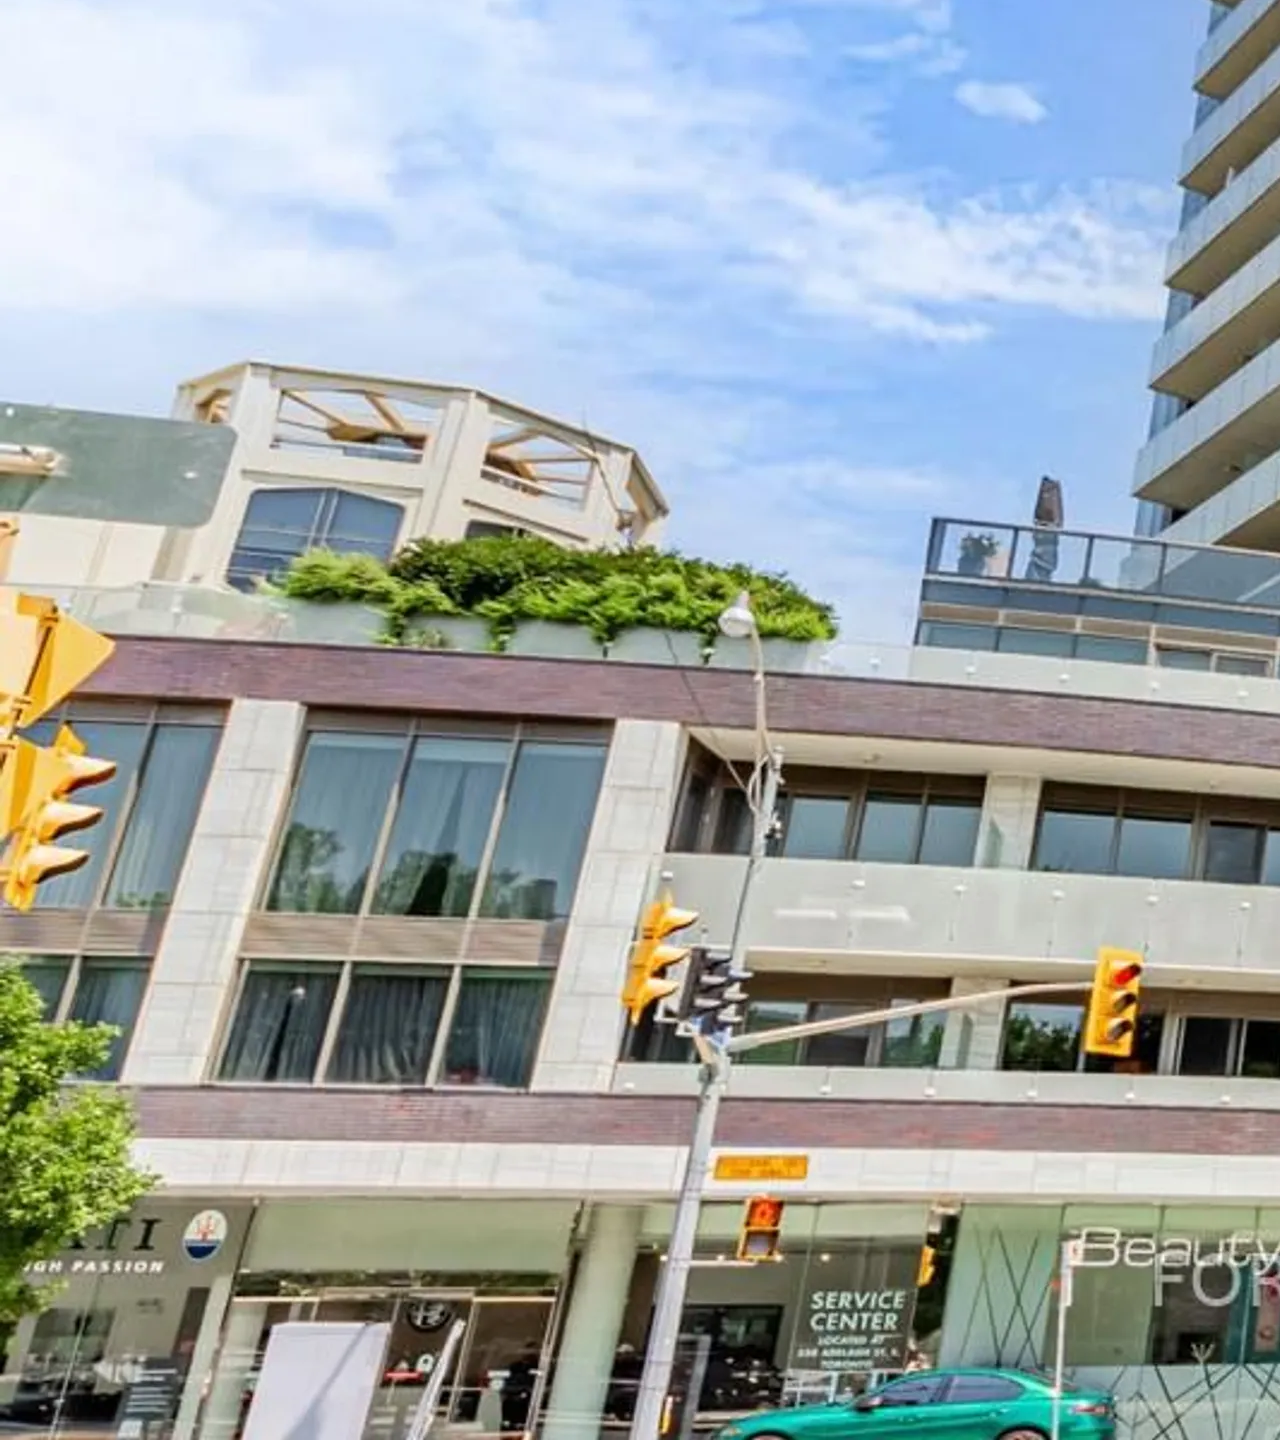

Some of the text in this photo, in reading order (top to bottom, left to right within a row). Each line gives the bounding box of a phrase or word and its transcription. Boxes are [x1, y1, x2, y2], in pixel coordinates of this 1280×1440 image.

[71, 1261, 165, 1273] PASSION
[810, 1290, 907, 1310] SERVICE
[809, 1311, 899, 1331] CENTER
[818, 1334, 868, 1346] LOCATED
[821, 1360, 875, 1370] TORONTO
